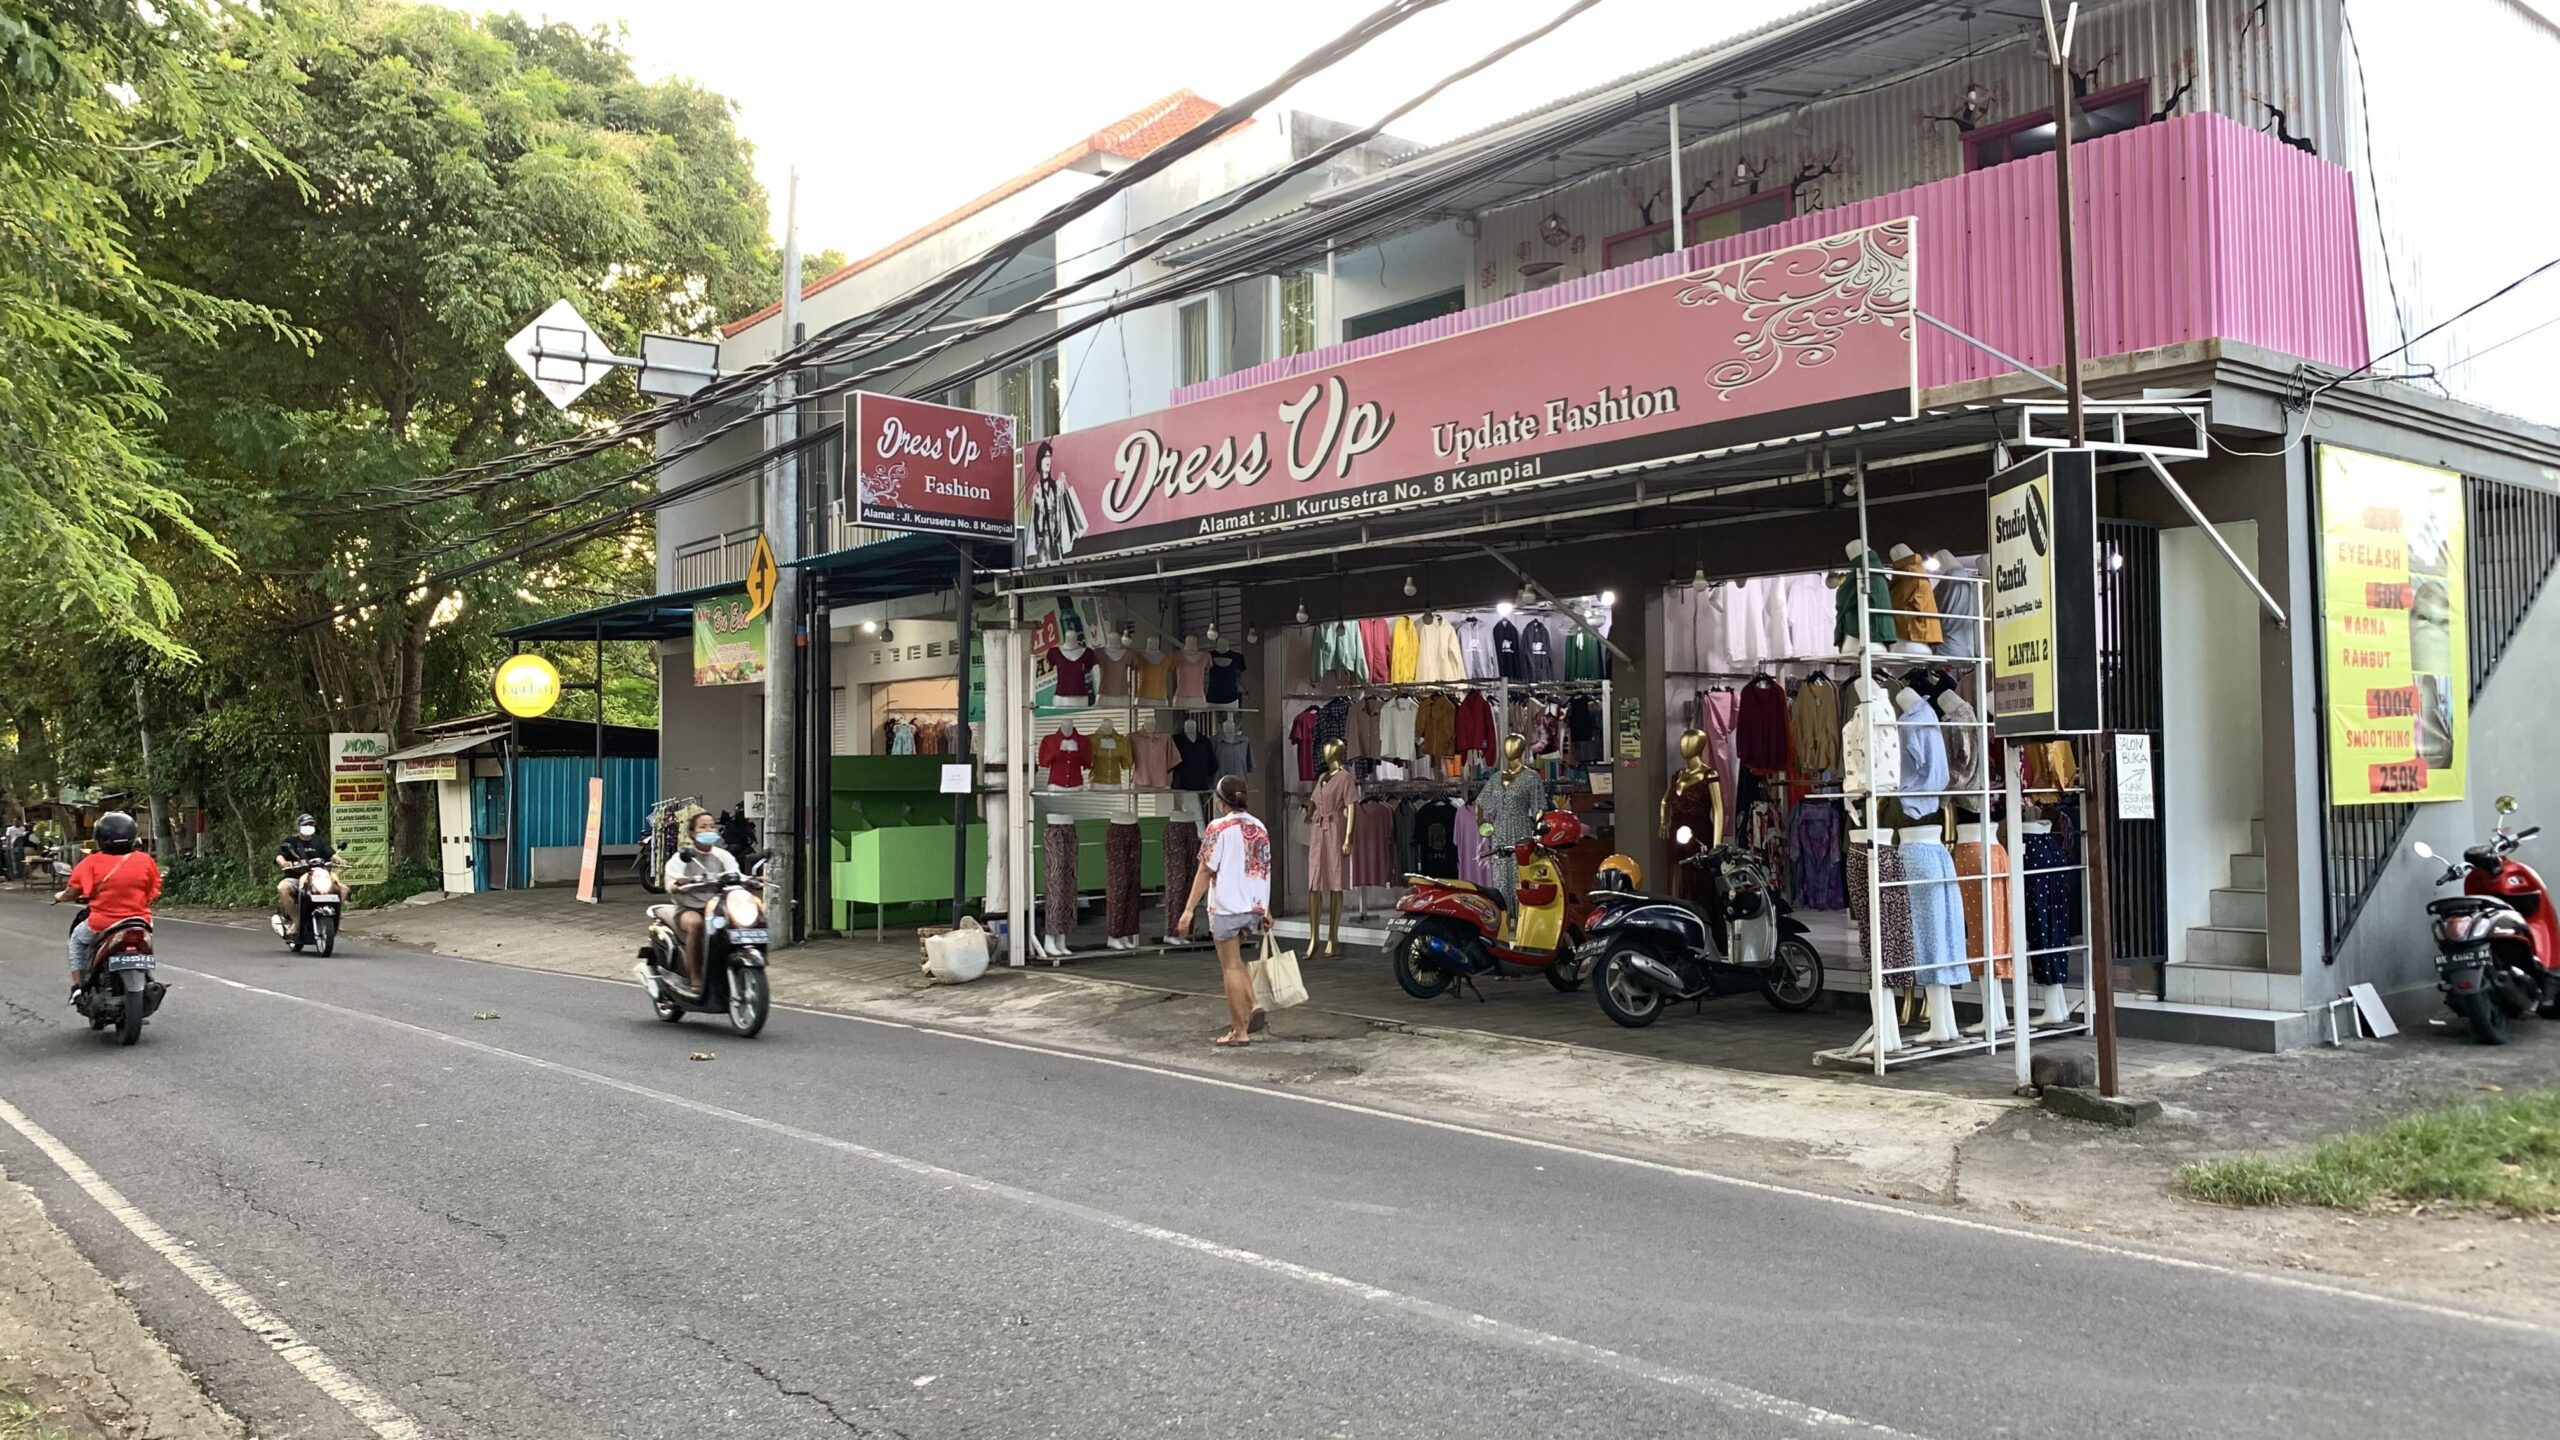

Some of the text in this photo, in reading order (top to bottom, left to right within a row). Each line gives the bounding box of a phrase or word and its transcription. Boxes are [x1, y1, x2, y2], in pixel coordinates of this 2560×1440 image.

[1431, 385, 1679, 464] Update Fashion
[877, 417, 980, 468] Dress Up
[1102, 375, 1395, 522] Dress Up
[924, 475, 991, 500] Fashion
[1199, 511, 1255, 534] Alamat
[1270, 504, 1291, 522] Jl.
[1297, 490, 1389, 517] Kurusetra
[1395, 483, 1427, 502] No.
[1434, 477, 1445, 493] 8
[1452, 458, 1541, 488] Kampial
[863, 508, 895, 520] Alamat
[914, 514, 956, 527] Kurusetra
[957, 518, 971, 529] No.
[973, 521, 978, 530] 8
[980, 522, 1013, 534] Kampial
[1996, 508, 2027, 543] Studio
[2338, 542, 2401, 569] EYELASH
[1996, 558, 2027, 593] Cantik
[2373, 582, 2404, 610] 50K
[2344, 615, 2387, 636] WARNA
[2008, 638, 2048, 667] LANTAI 2
[2343, 648, 2391, 669] RAMBUT
[2373, 689, 2413, 716] 100K
[2117, 736, 2144, 751] SALON
[2346, 730, 2410, 748] SMOOTHING
[2122, 752, 2149, 765] BUKA
[2379, 764, 2420, 792] 250K
